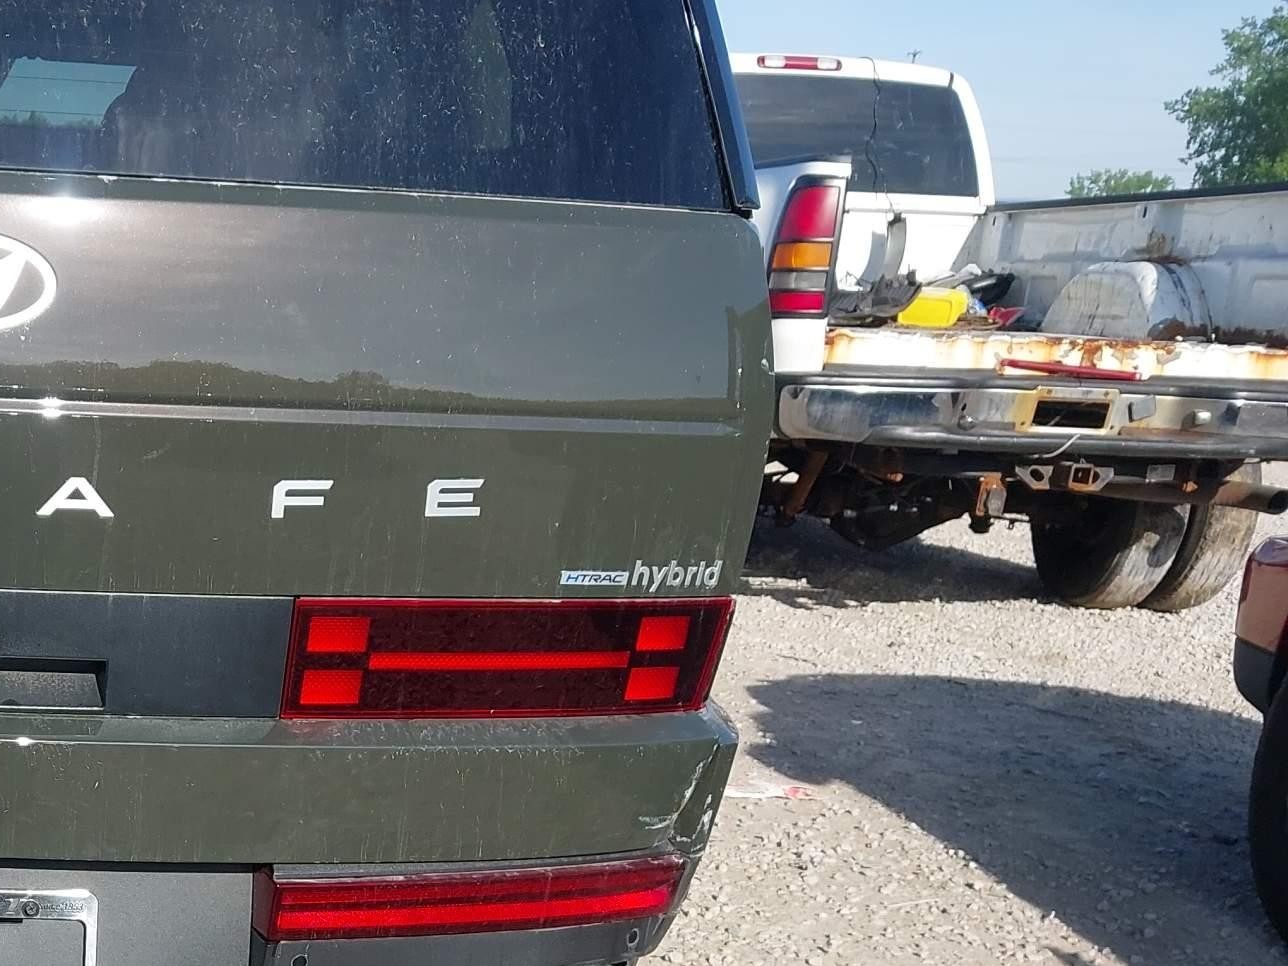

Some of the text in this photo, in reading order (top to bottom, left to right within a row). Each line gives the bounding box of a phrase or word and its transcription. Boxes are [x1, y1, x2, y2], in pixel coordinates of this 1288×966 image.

[270, 478, 485, 519] FE
[565, 559, 724, 593] HTRAC hybrid
